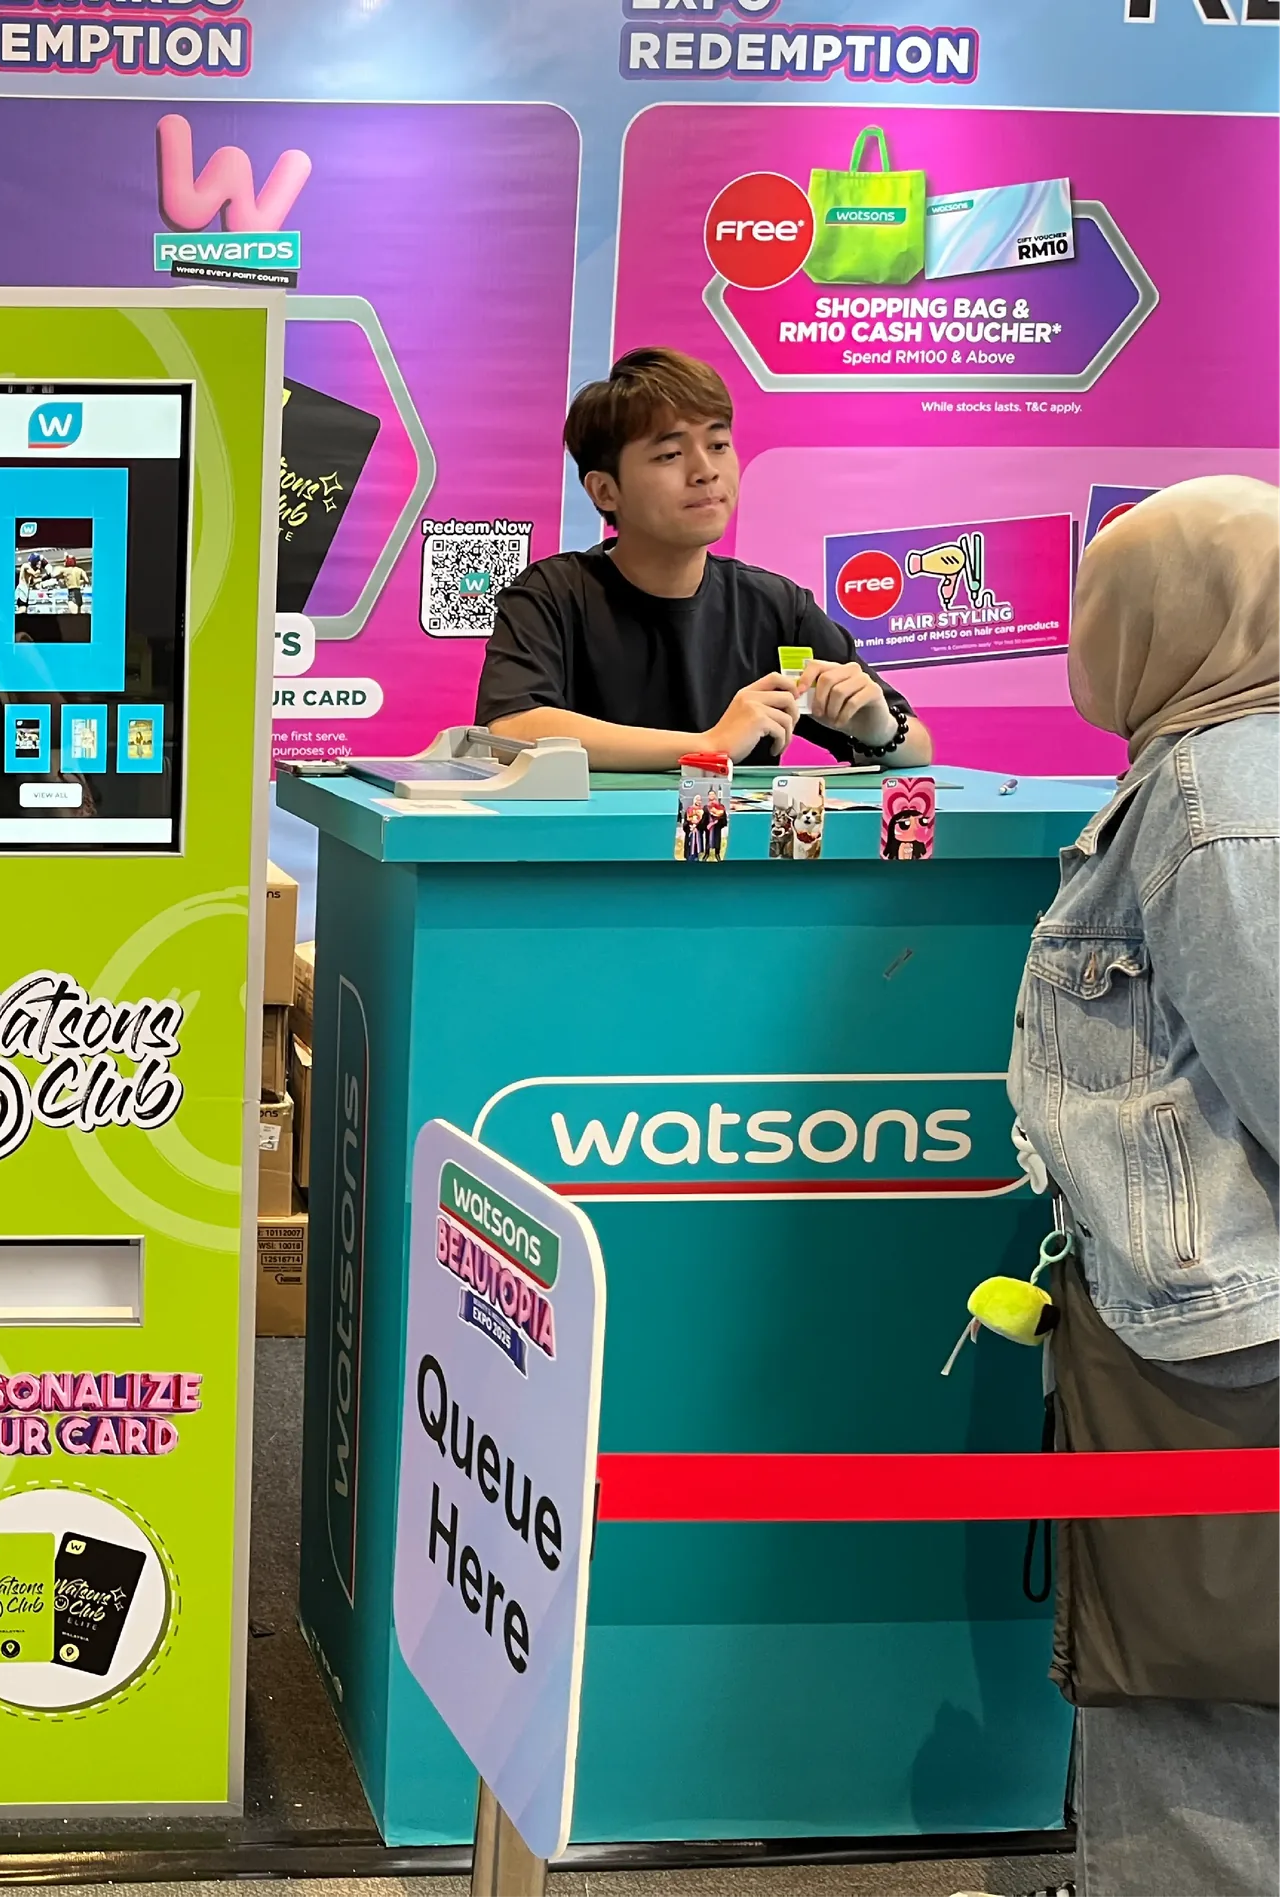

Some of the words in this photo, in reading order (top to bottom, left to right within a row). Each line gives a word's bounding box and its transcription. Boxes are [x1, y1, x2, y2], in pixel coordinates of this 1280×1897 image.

[629, 32, 970, 74] REDEMPTION
[836, 209, 896, 222] watsons
[1016, 236, 1035, 245] GIFT
[1037, 232, 1068, 243] VOUCHER
[1018, 238, 1069, 260] RM10
[815, 297, 947, 319] SHOPPING
[953, 298, 1007, 319] BAG
[1011, 298, 1030, 319] &
[779, 322, 845, 343] RM10
[852, 322, 922, 343] CASH
[842, 350, 892, 365] Spend
[895, 350, 947, 364] RM100
[950, 351, 962, 364] &
[966, 351, 1015, 364] Above
[921, 401, 953, 412] While
[956, 402, 992, 412] stocks
[994, 402, 1022, 412] lasts.
[1025, 402, 1048, 413] T&C
[1050, 403, 1083, 414] apply.
[422, 520, 490, 534] Redeem
[494, 521, 532, 534] Now
[890, 614, 933, 631] HAIR
[938, 608, 1012, 626] STYLING
[866, 637, 883, 647] min
[886, 634, 915, 648] spend
[917, 632, 928, 642] of
[930, 630, 957, 640] RM50
[959, 629, 972, 637] on
[974, 626, 992, 636] hair
[995, 624, 1015, 633] care
[1017, 620, 1059, 635] products
[303, 690, 367, 706] CARD
[291, 731, 312, 741] first
[315, 733, 347, 741] serve.
[272, 747, 324, 757] purposes
[327, 745, 353, 757] only.
[33, 791, 53, 799] VIEW
[55, 791, 68, 799] ALL
[37, 1058, 175, 1123] Club
[551, 1103, 972, 1166] watsons
[453, 1178, 541, 1266] watsons
[335, 1073, 359, 1498] watsons
[436, 1217, 556, 1358] BEAUTOPIA
[473, 1306, 492, 1330] EXPO
[492, 1321, 511, 1349] 2025
[56, 1416, 179, 1457] CARD
[417, 1354, 562, 1571] Queue
[428, 1481, 530, 1674] Here
[7, 1596, 44, 1613] Club
[69, 1600, 105, 1621] Club
[67, 1617, 97, 1630] ELITE
